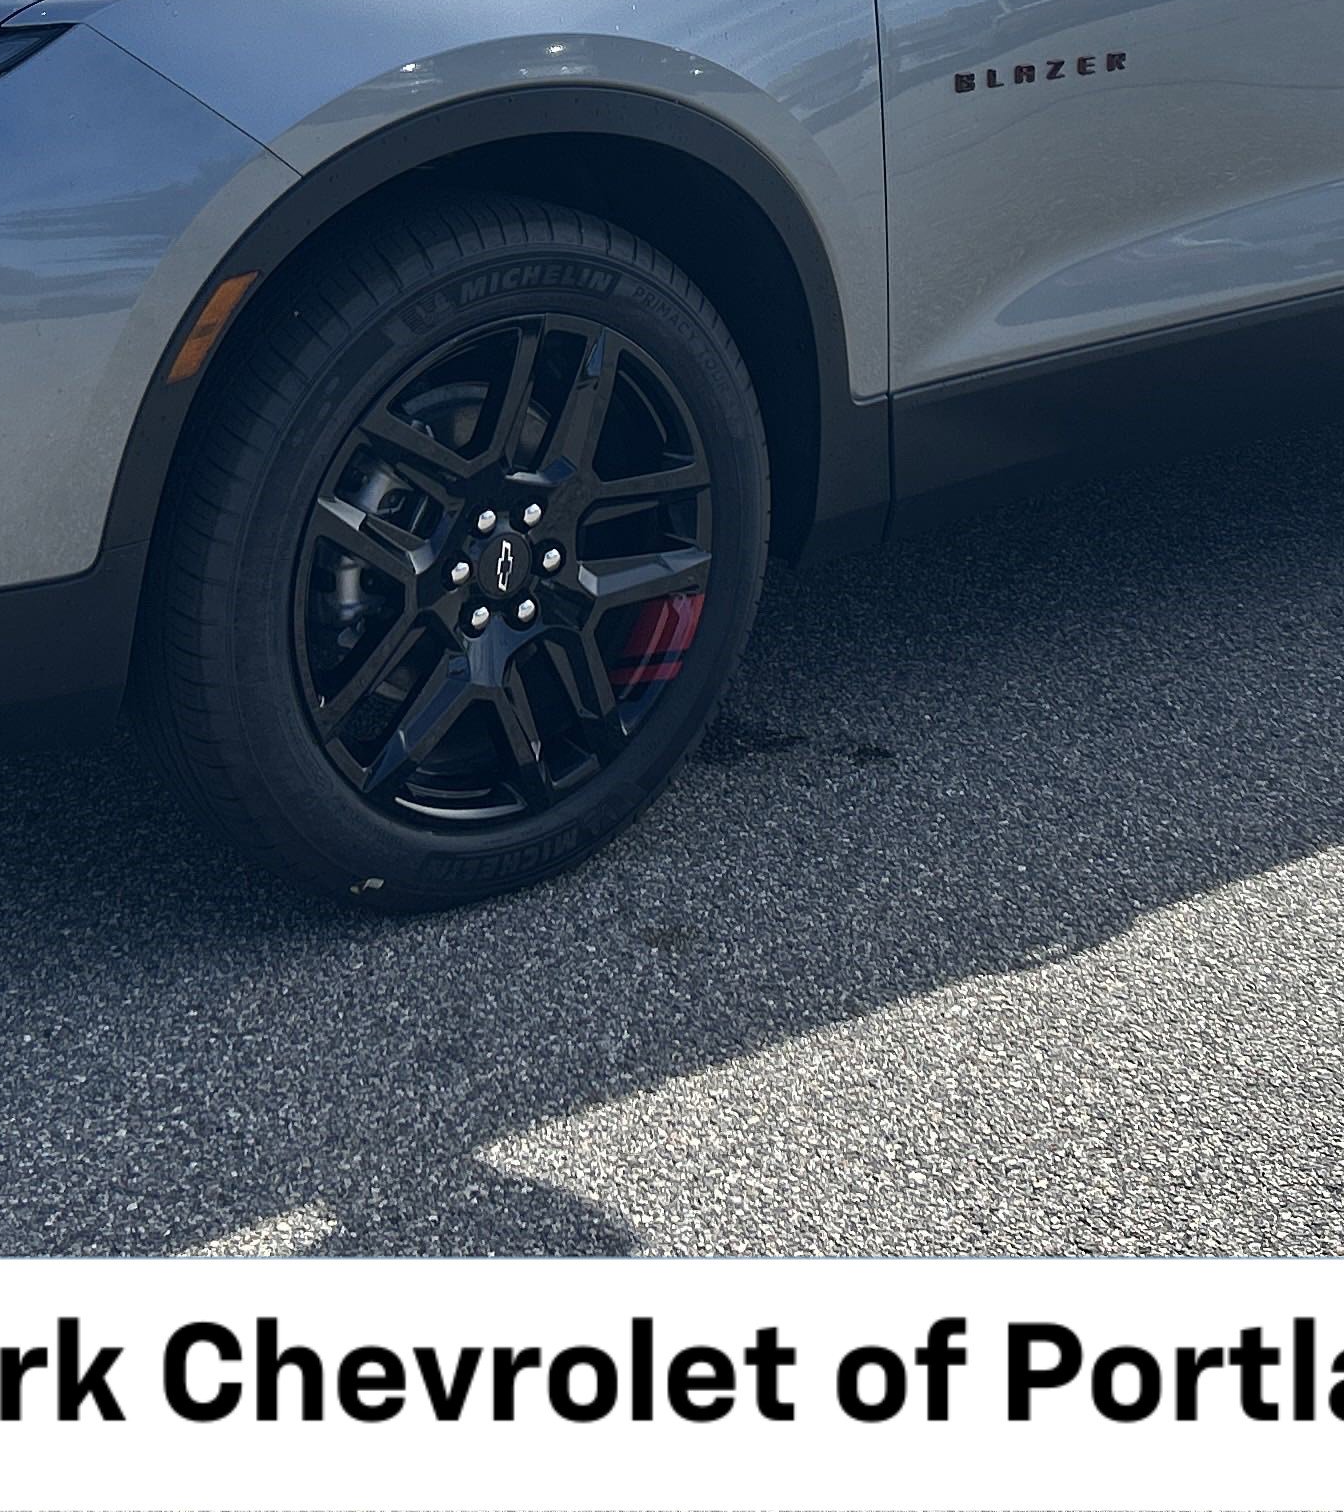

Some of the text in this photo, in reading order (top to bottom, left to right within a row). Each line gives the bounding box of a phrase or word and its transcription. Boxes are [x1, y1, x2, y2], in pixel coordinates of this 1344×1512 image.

[954, 52, 1127, 94] BLAZER
[460, 264, 614, 304] MICHELIN
[631, 286, 698, 341] PRIMACY
